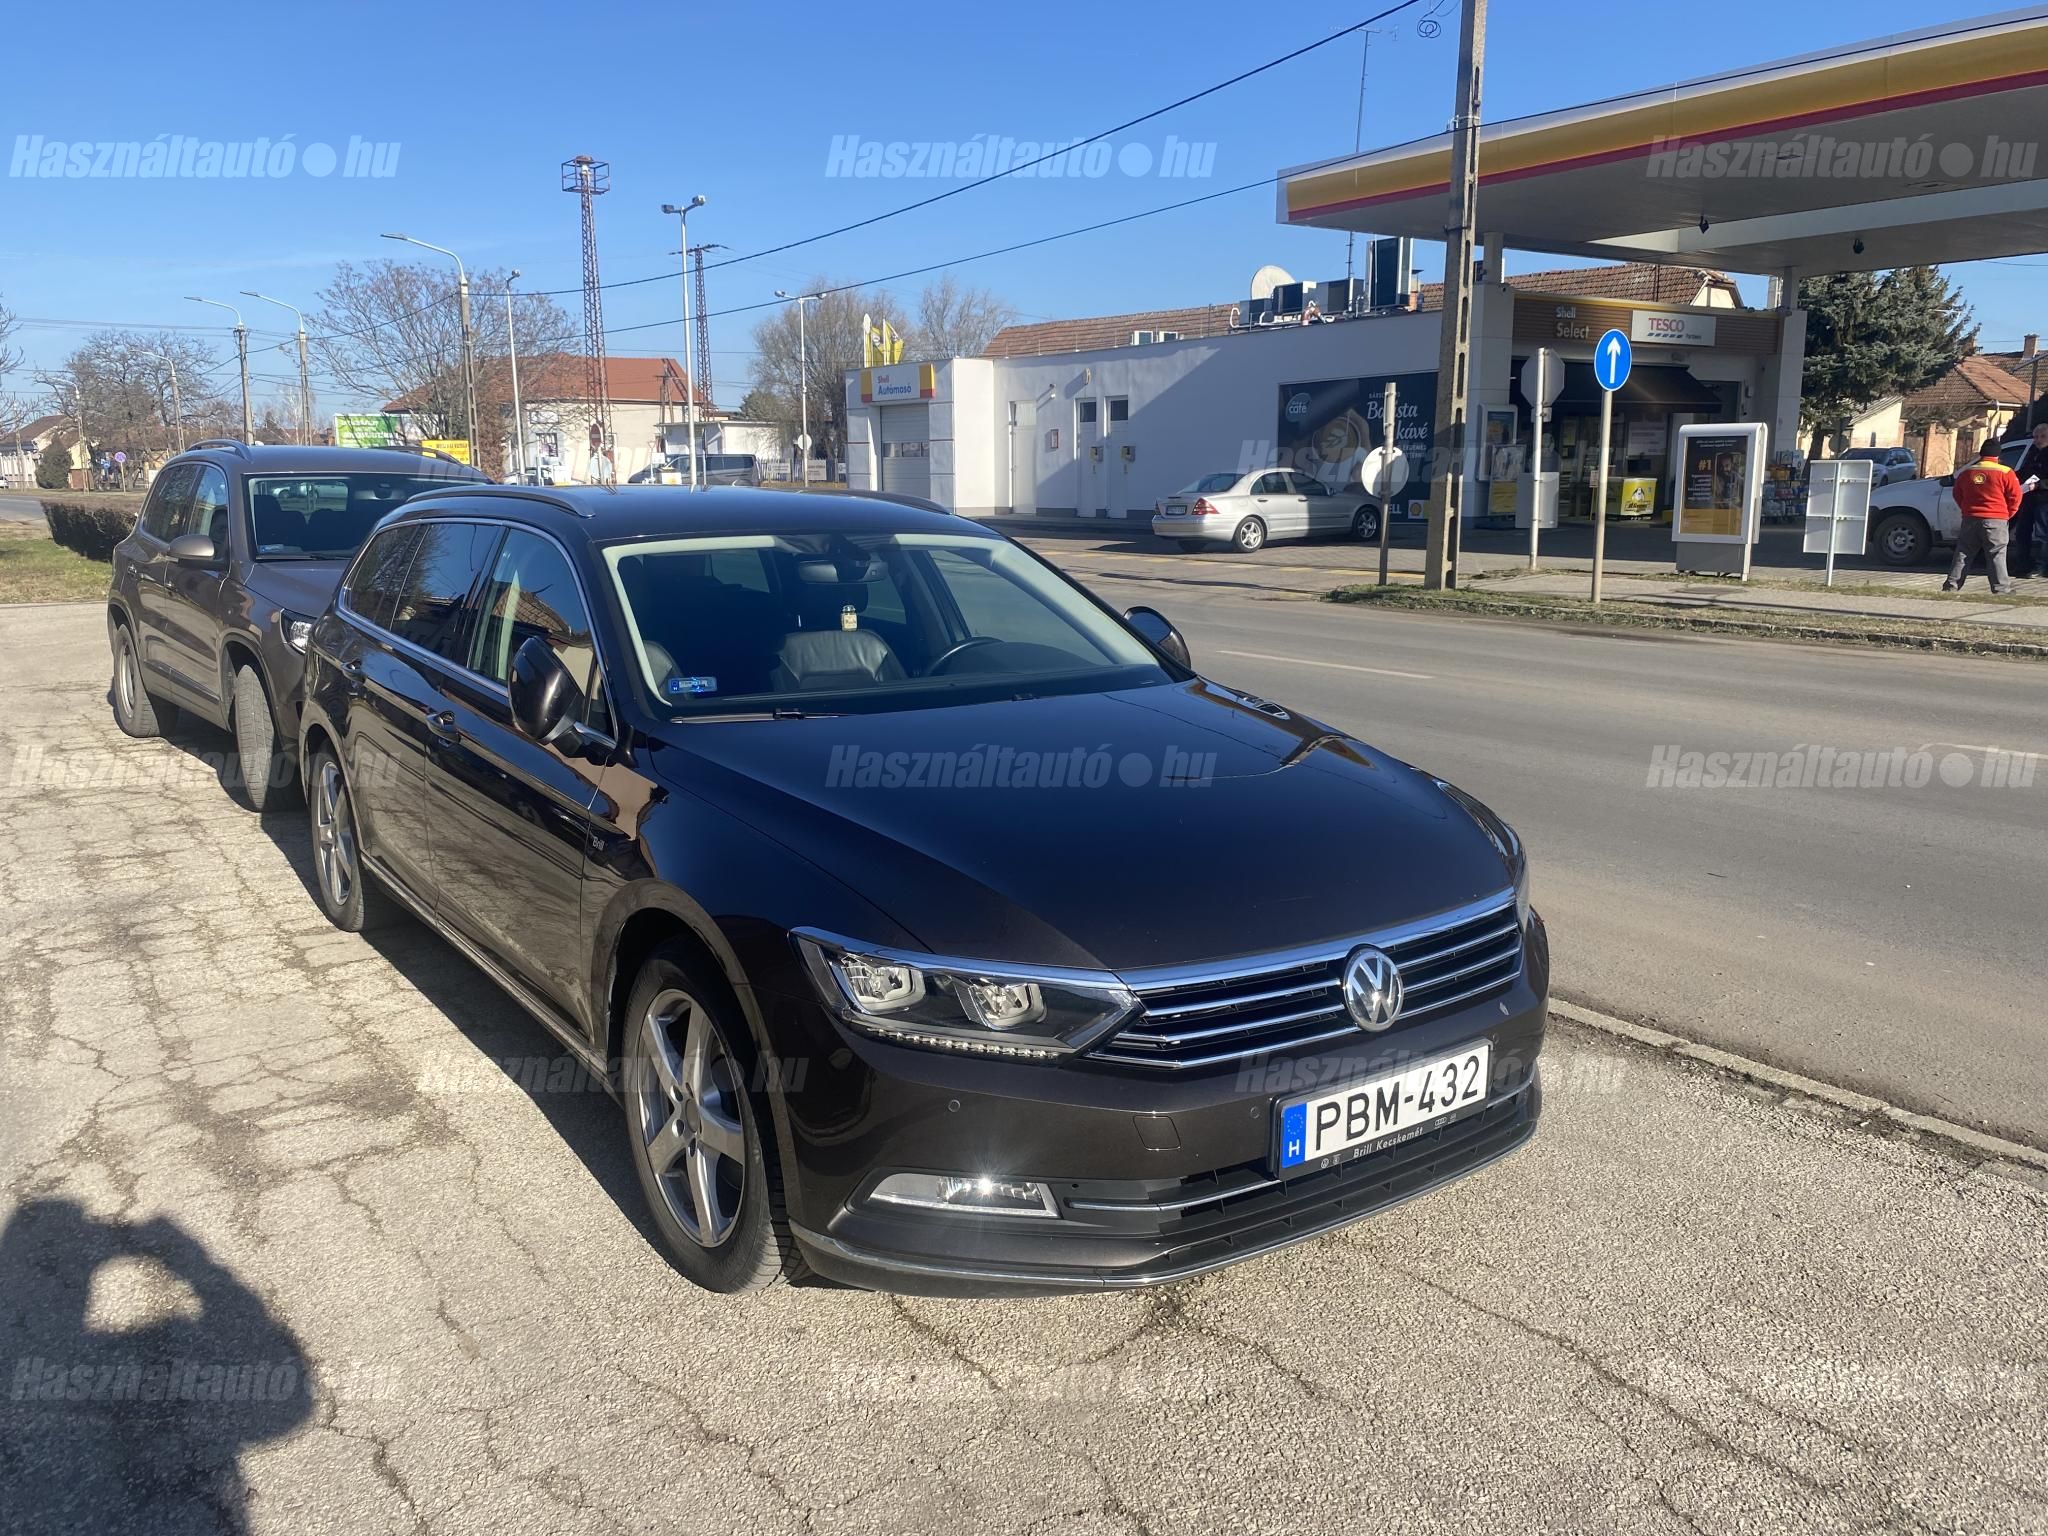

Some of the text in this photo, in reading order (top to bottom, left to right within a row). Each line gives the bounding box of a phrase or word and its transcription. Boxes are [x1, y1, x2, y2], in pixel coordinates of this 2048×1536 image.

[1556, 305, 1576, 319] Shell
[1556, 322, 1590, 339] Select
[1648, 317, 1685, 332] TESCO
[1367, 400, 1418, 420] Basta
[1396, 420, 1428, 440] kávé
[1698, 459, 1712, 471] #1
[1316, 1055, 1480, 1151] PBM-432
[1288, 1139, 1300, 1157] H
[1353, 1127, 1424, 1158] Brill Kecskemét
